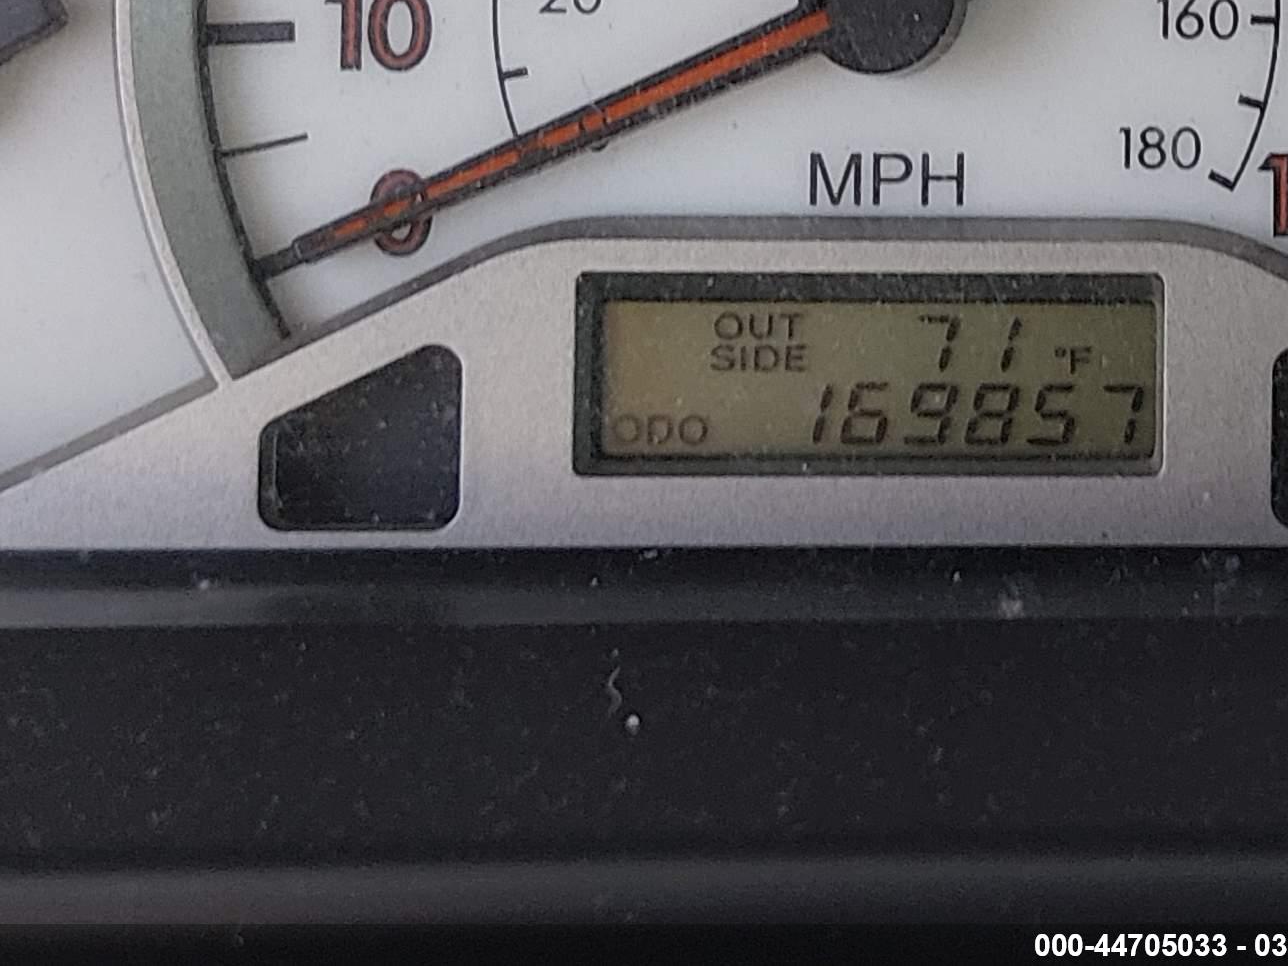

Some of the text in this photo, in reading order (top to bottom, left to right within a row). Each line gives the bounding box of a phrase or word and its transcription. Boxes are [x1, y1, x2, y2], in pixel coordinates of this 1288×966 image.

[1120, 127, 1201, 169] 180
[810, 153, 964, 206] MPH
[709, 345, 808, 372] SIDE
[713, 311, 803, 341] OUT
[917, 314, 1024, 372] 71
[611, 382, 1145, 446] ODO 169857
